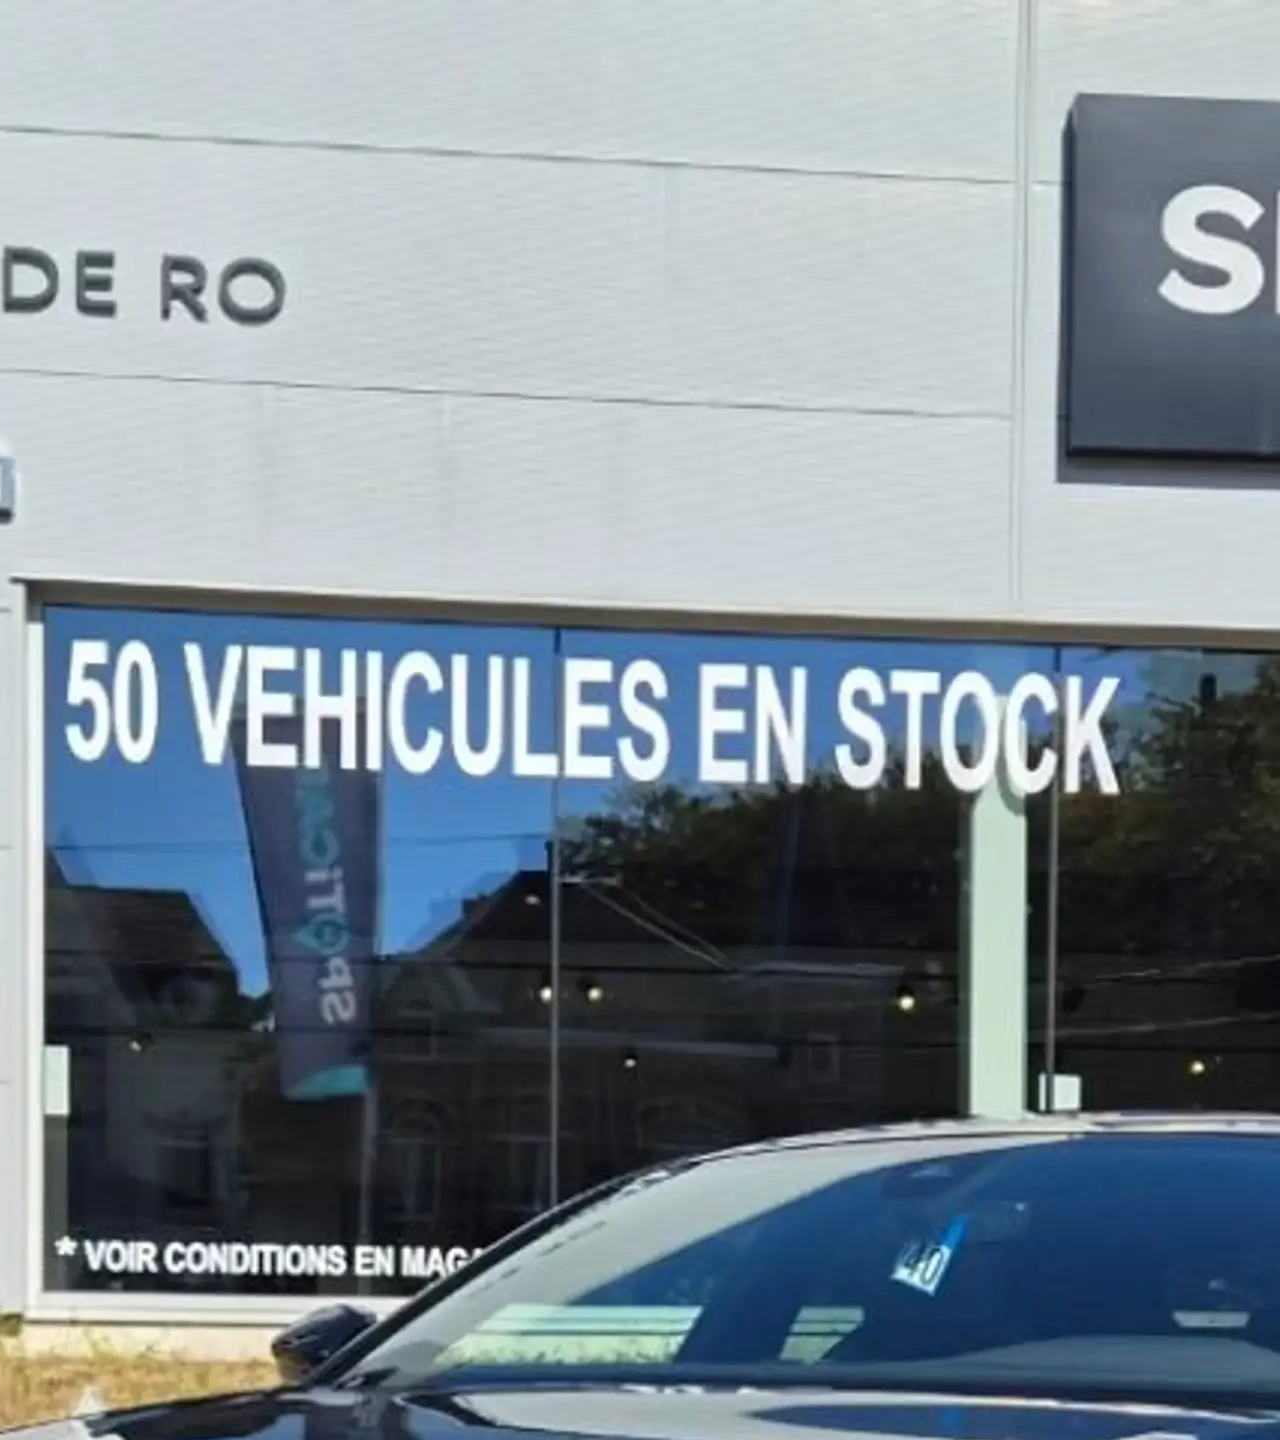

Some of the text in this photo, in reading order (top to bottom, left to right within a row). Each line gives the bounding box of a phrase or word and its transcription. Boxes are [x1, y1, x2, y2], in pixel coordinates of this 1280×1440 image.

[2, 246, 287, 327] DE RO
[65, 639, 1121, 796] 50 VEHICULES EN STOCK
[84, 1240, 158, 1273] VOIR
[164, 1241, 347, 1276] CONDITIONS
[355, 1245, 394, 1276] EN
